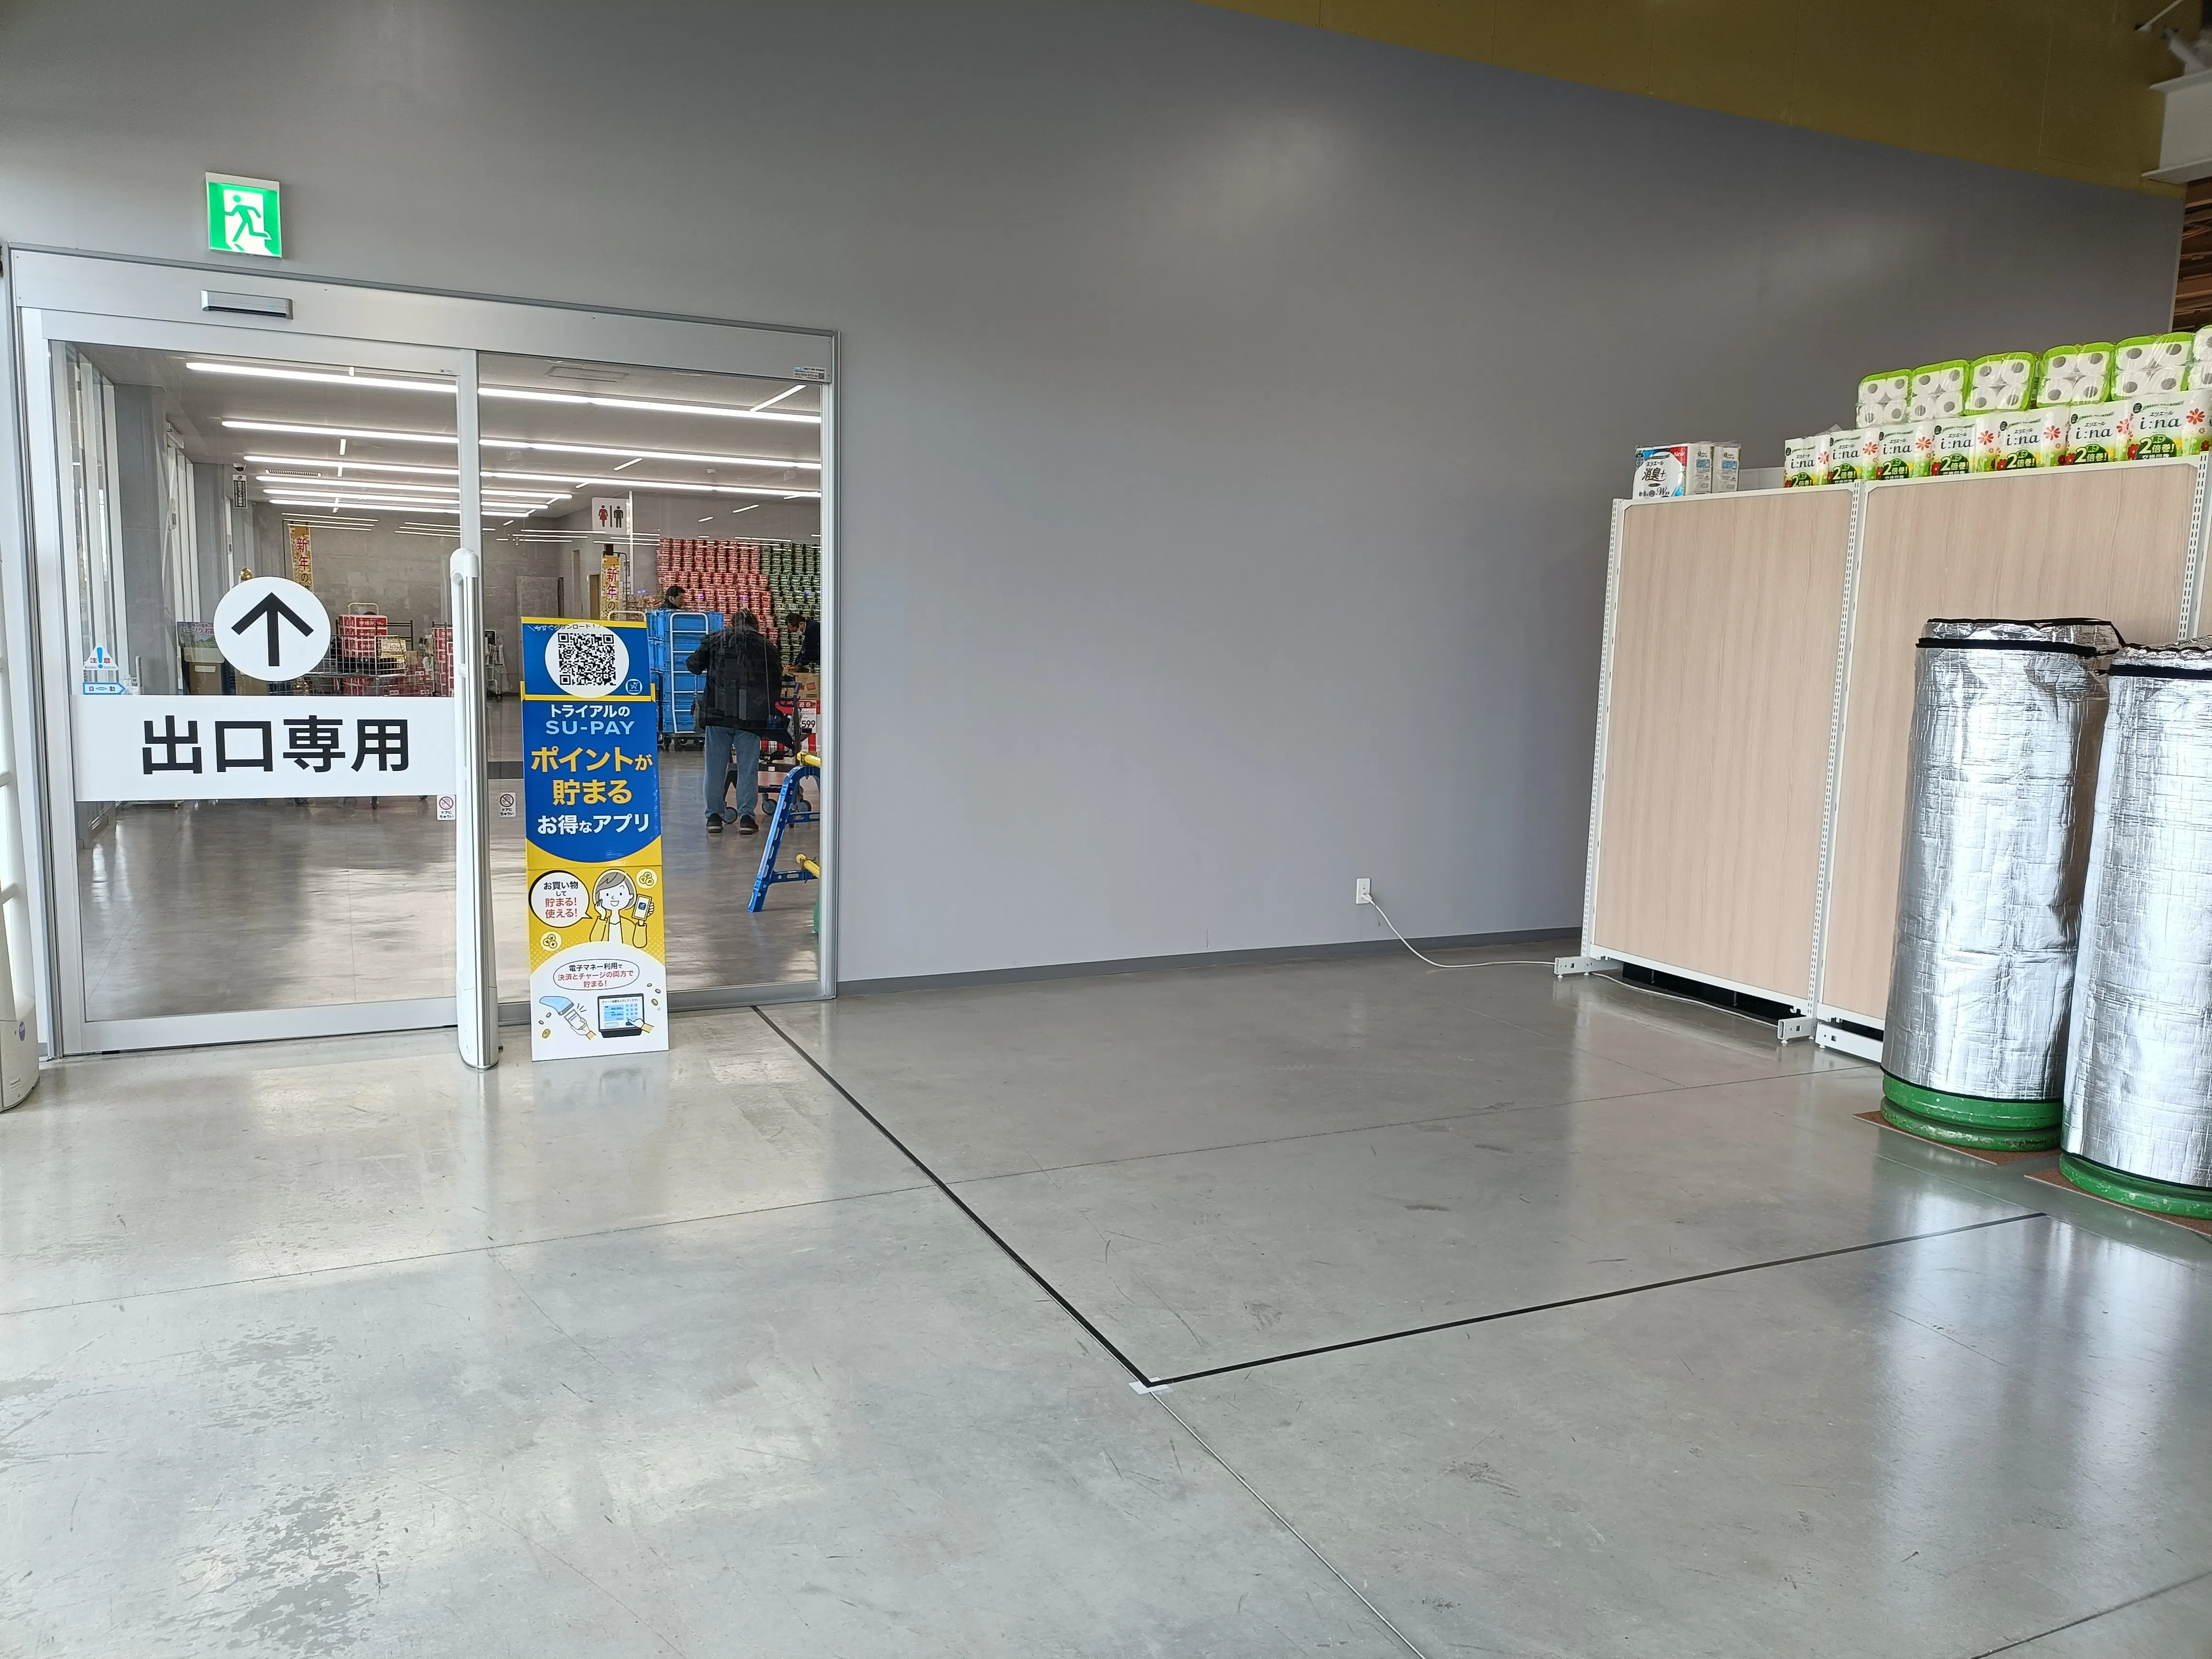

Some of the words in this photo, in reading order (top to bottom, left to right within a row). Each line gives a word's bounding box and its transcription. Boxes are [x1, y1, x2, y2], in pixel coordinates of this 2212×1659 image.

[551, 704, 630, 718] トライアルの
[545, 720, 635, 735] SU-PAY
[801, 720, 816, 728] 599
[142, 714, 409, 775] 出口専用
[531, 746, 653, 773] ポイントが
[553, 779, 632, 806] 貯まる
[537, 814, 649, 835] お得なアプリ
[543, 881, 578, 890] お買い物
[569, 962, 622, 972] 電子マネー利用で
[558, 970, 634, 981] 決済とチャージの両方で
